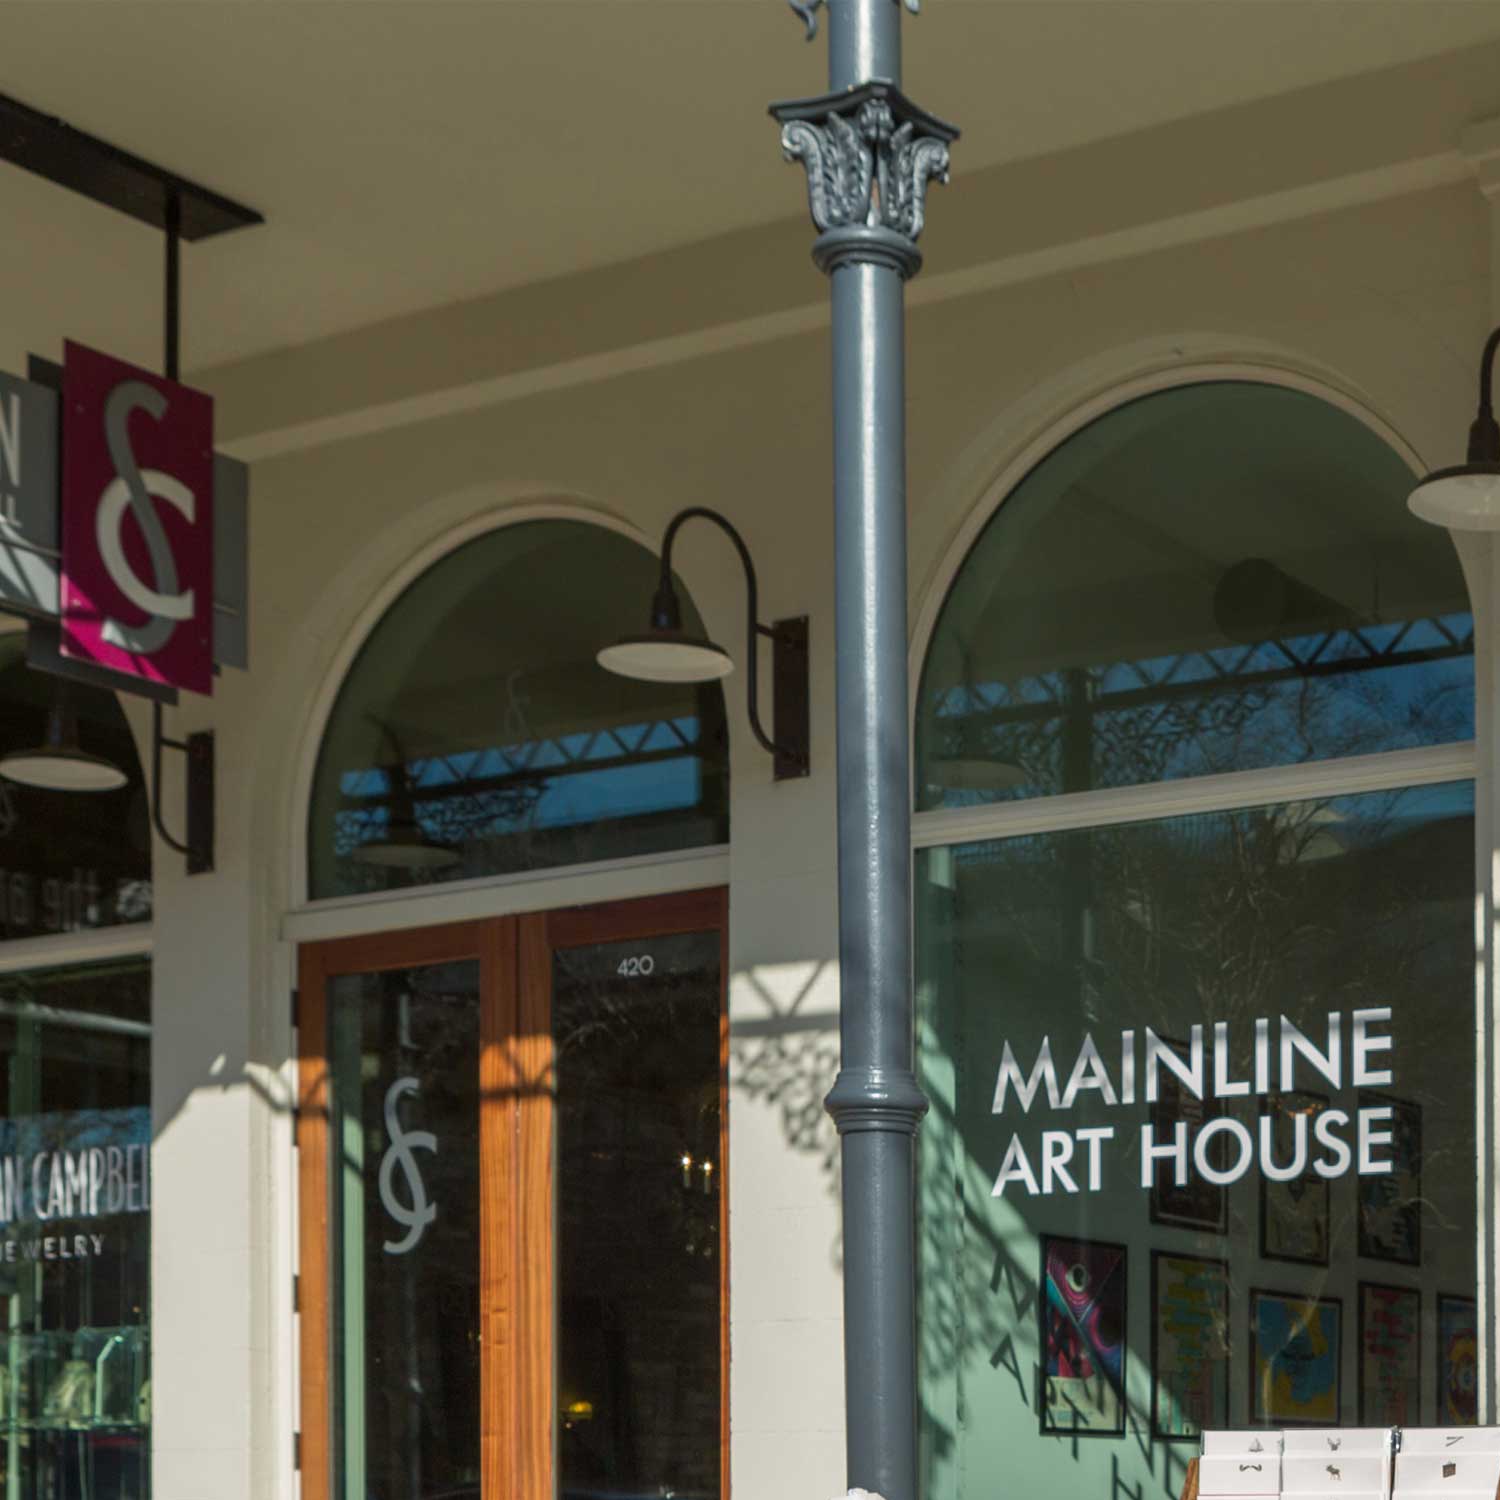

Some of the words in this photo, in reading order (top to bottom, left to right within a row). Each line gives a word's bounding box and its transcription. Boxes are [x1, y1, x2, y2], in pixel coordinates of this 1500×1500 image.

[617, 955, 654, 976] 420
[991, 1007, 1392, 1114] MAINLINE
[991, 1127, 1114, 1197] ART
[1141, 1107, 1392, 1187] HOUSE
[0, 1234, 104, 1263] EWELRY
